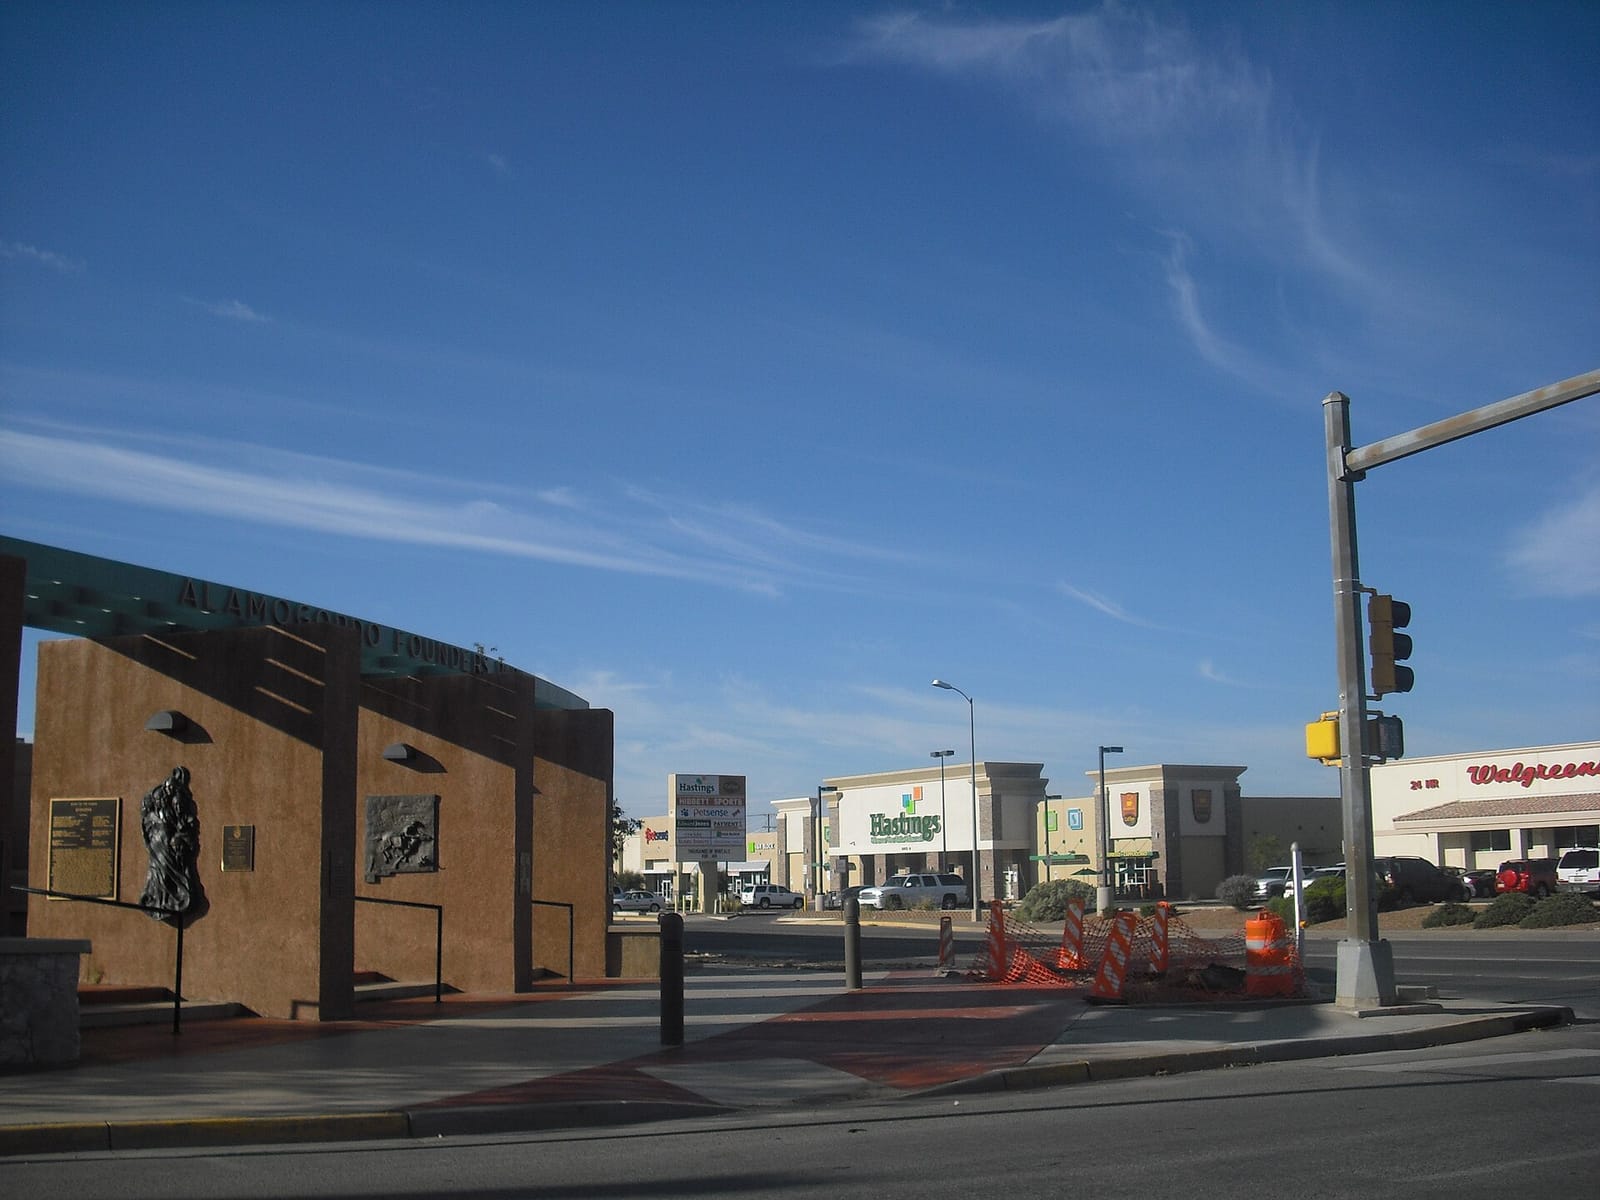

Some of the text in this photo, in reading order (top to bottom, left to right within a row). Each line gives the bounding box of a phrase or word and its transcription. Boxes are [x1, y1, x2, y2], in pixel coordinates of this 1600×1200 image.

[1467, 761, 1600, 788] Walgreen
[679, 783, 715, 794] Hastings
[693, 807, 729, 817] Petsense
[870, 812, 941, 842] Hastings
